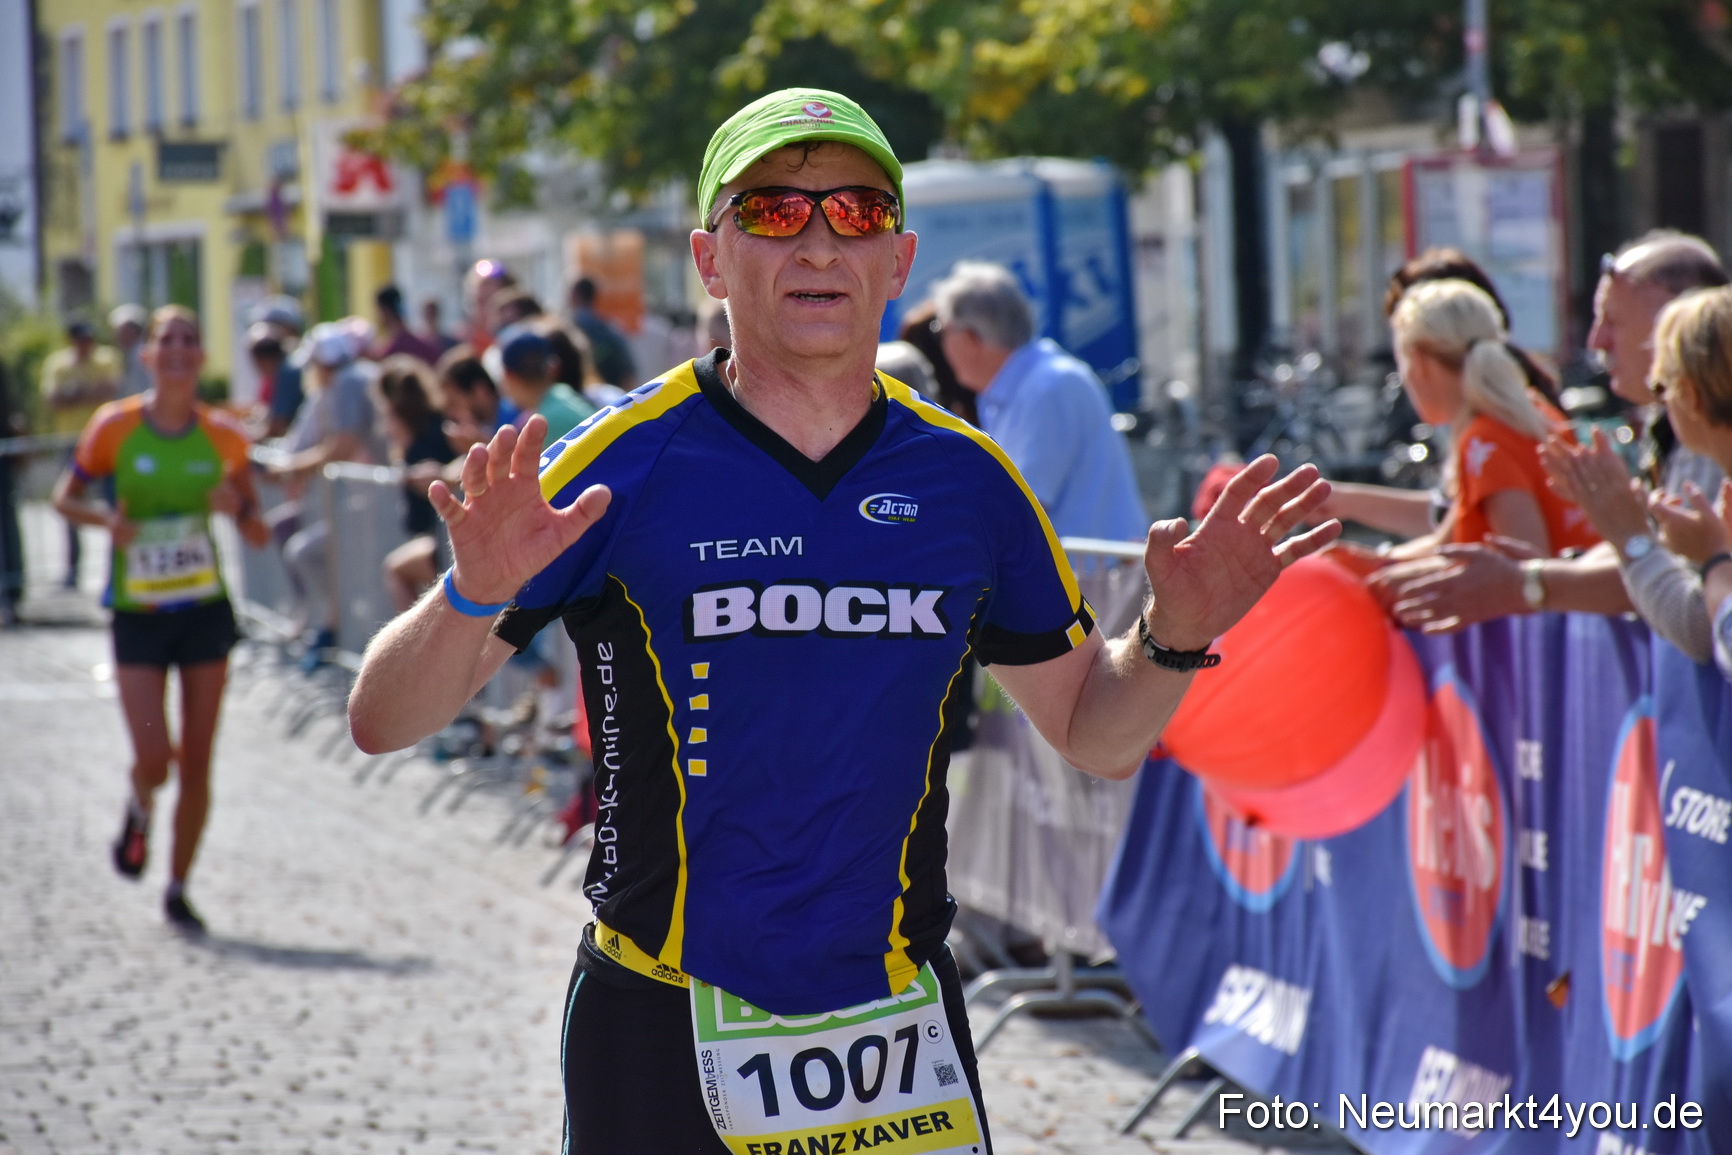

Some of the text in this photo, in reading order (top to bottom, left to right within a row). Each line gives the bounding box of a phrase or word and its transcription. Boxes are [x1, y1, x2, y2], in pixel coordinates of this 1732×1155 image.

[690, 536, 803, 562] TEAM
[688, 582, 950, 640] BOCK
[603, 943, 623, 960] adidas
[651, 967, 684, 984] adidas
[736, 1023, 919, 1118] 1007
[853, 1110, 954, 1151] XAVER
